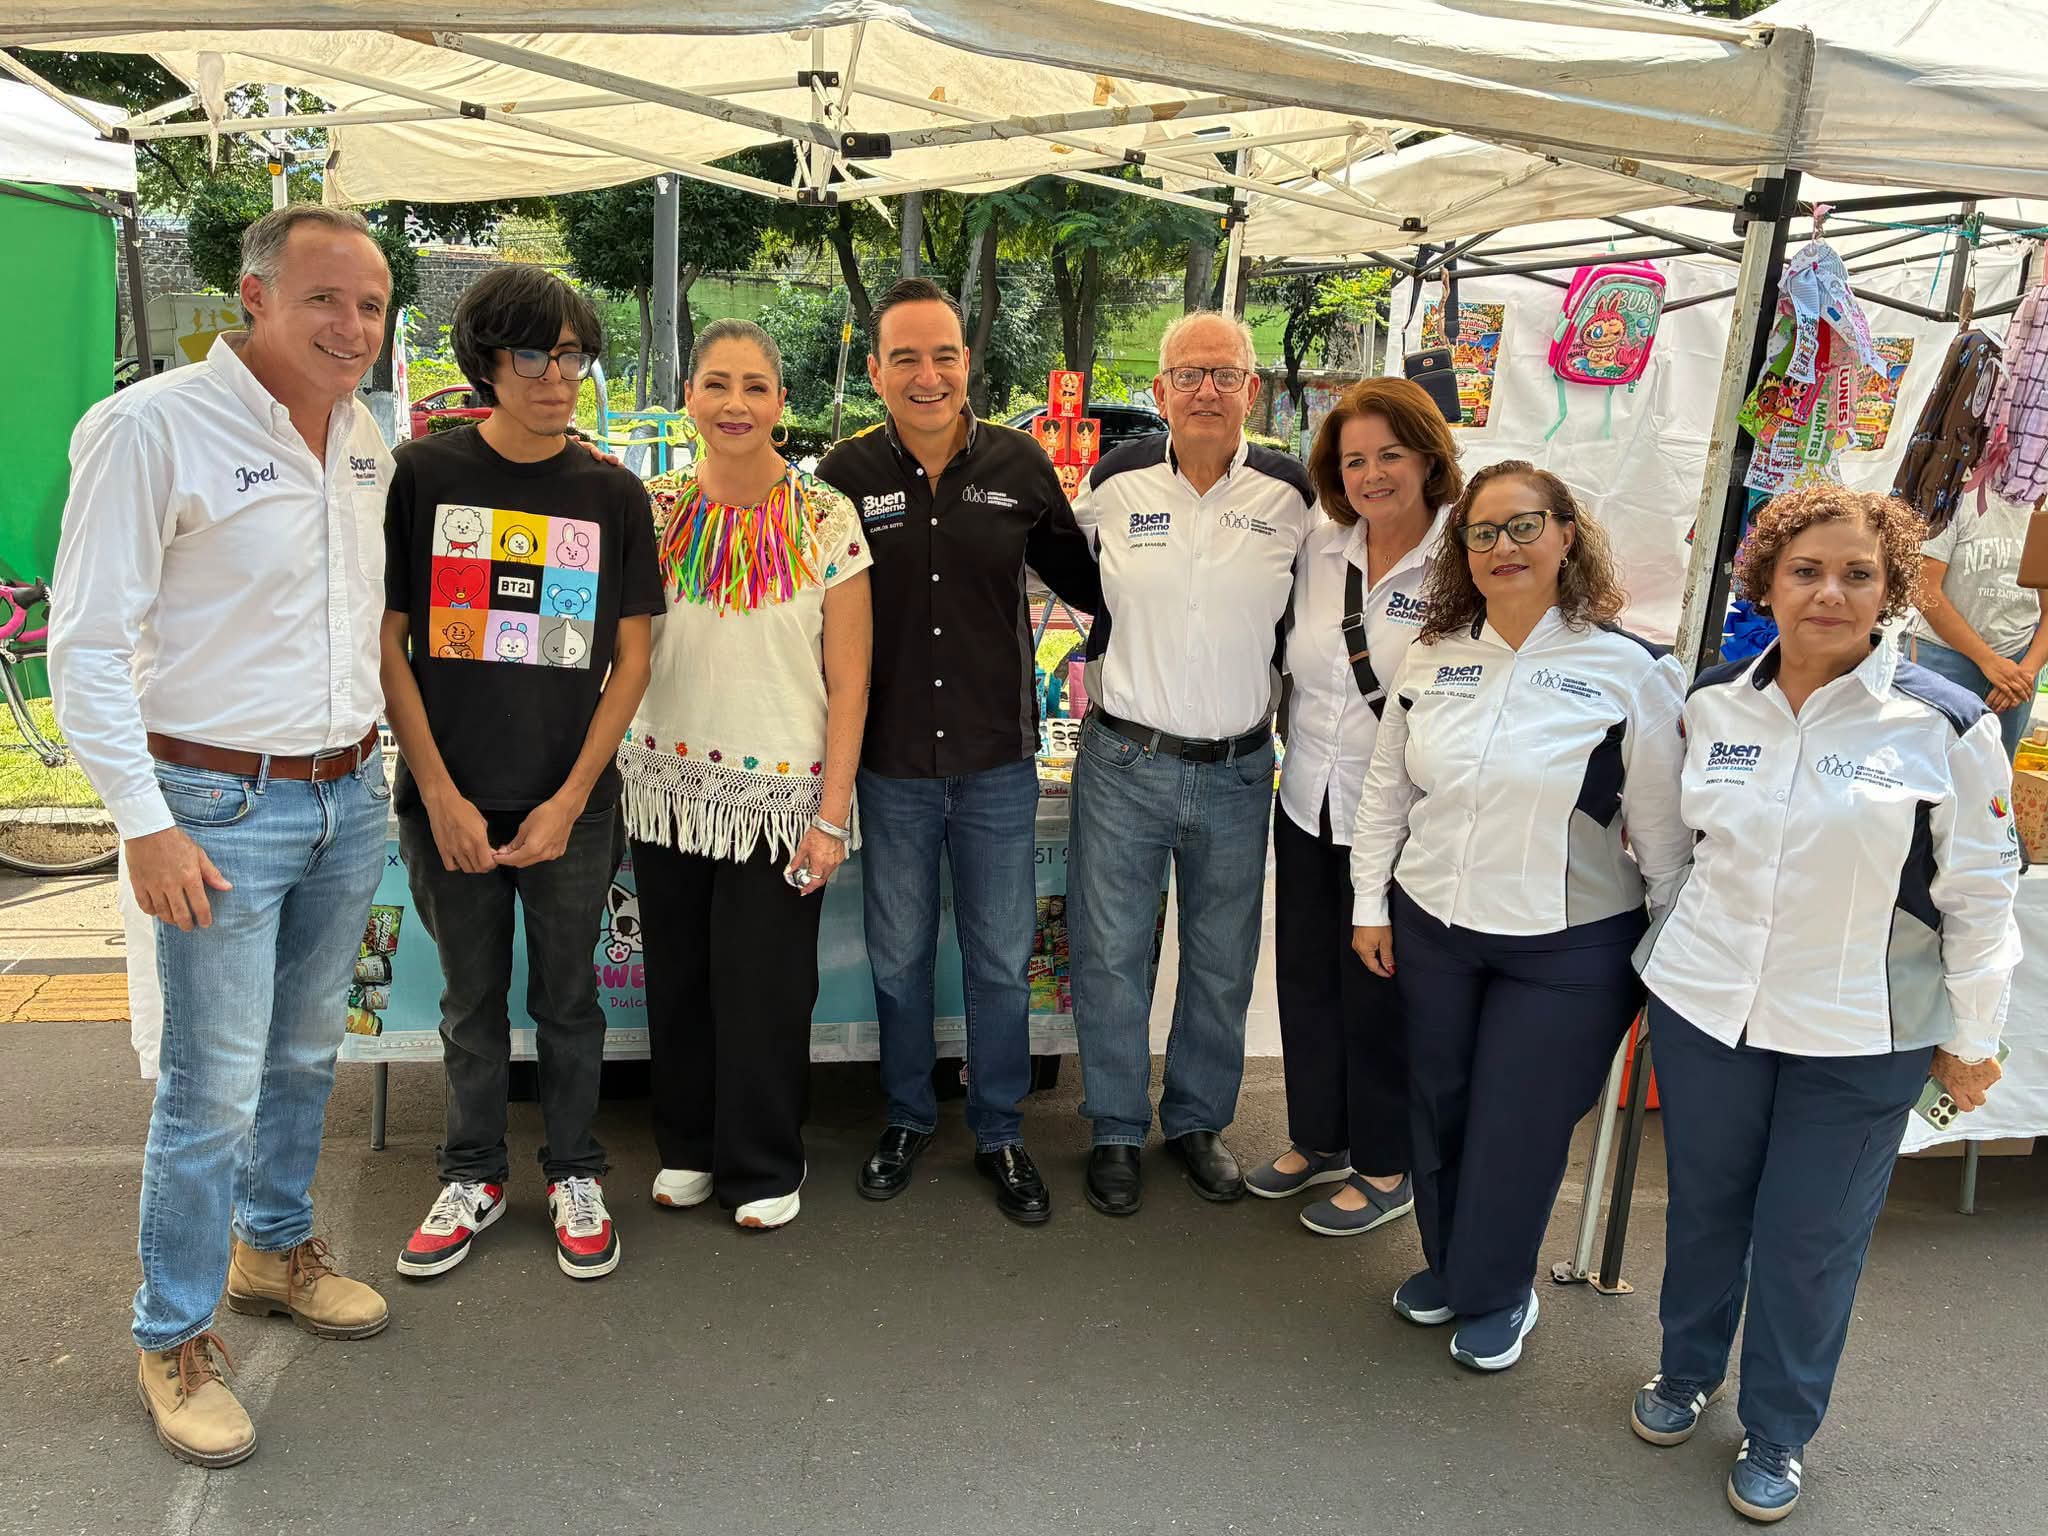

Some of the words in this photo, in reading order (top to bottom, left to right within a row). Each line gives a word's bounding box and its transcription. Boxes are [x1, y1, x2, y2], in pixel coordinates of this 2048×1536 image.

[1838, 367, 1850, 423] LUNES
[1808, 401, 1829, 459] MARTES
[235, 462, 279, 492] Joel
[863, 491, 906, 511] Buen
[864, 503, 906, 518] Gobierno
[1129, 513, 1171, 528] Buen
[1129, 524, 1170, 534] Gobierno
[1963, 537, 2012, 576] NEW
[501, 580, 531, 594] BT21
[1436, 665, 1483, 681] Buen
[1709, 741, 1762, 758] Buen
[1707, 756, 1757, 766] Gobierno
[610, 996, 647, 1009] Dulc
